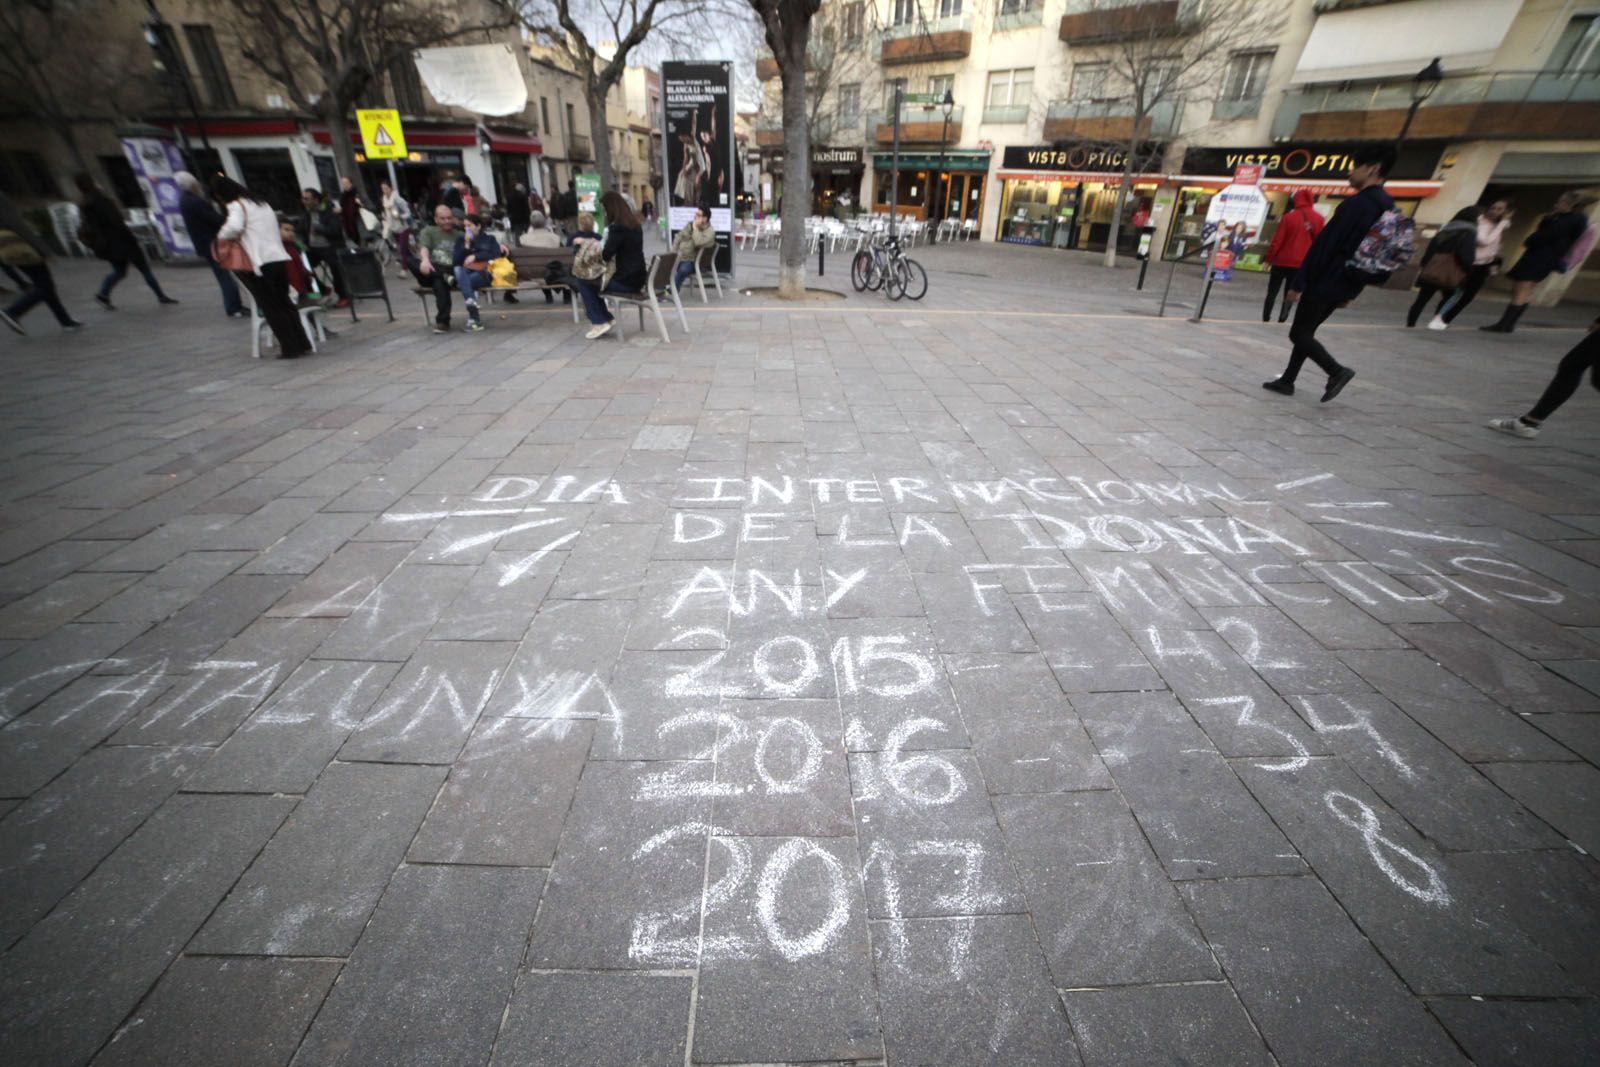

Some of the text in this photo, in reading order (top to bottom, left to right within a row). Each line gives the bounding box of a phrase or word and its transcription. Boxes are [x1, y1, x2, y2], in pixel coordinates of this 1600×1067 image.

[814, 149, 857, 162] nostrum
[472, 475, 630, 505] DIA
[671, 511, 1314, 556] DE LA DONA
[662, 566, 868, 619] ANY
[662, 625, 937, 698] 2015
[632, 694, 1416, 805] 2016 34
[628, 790, 1454, 984] 2017 8
